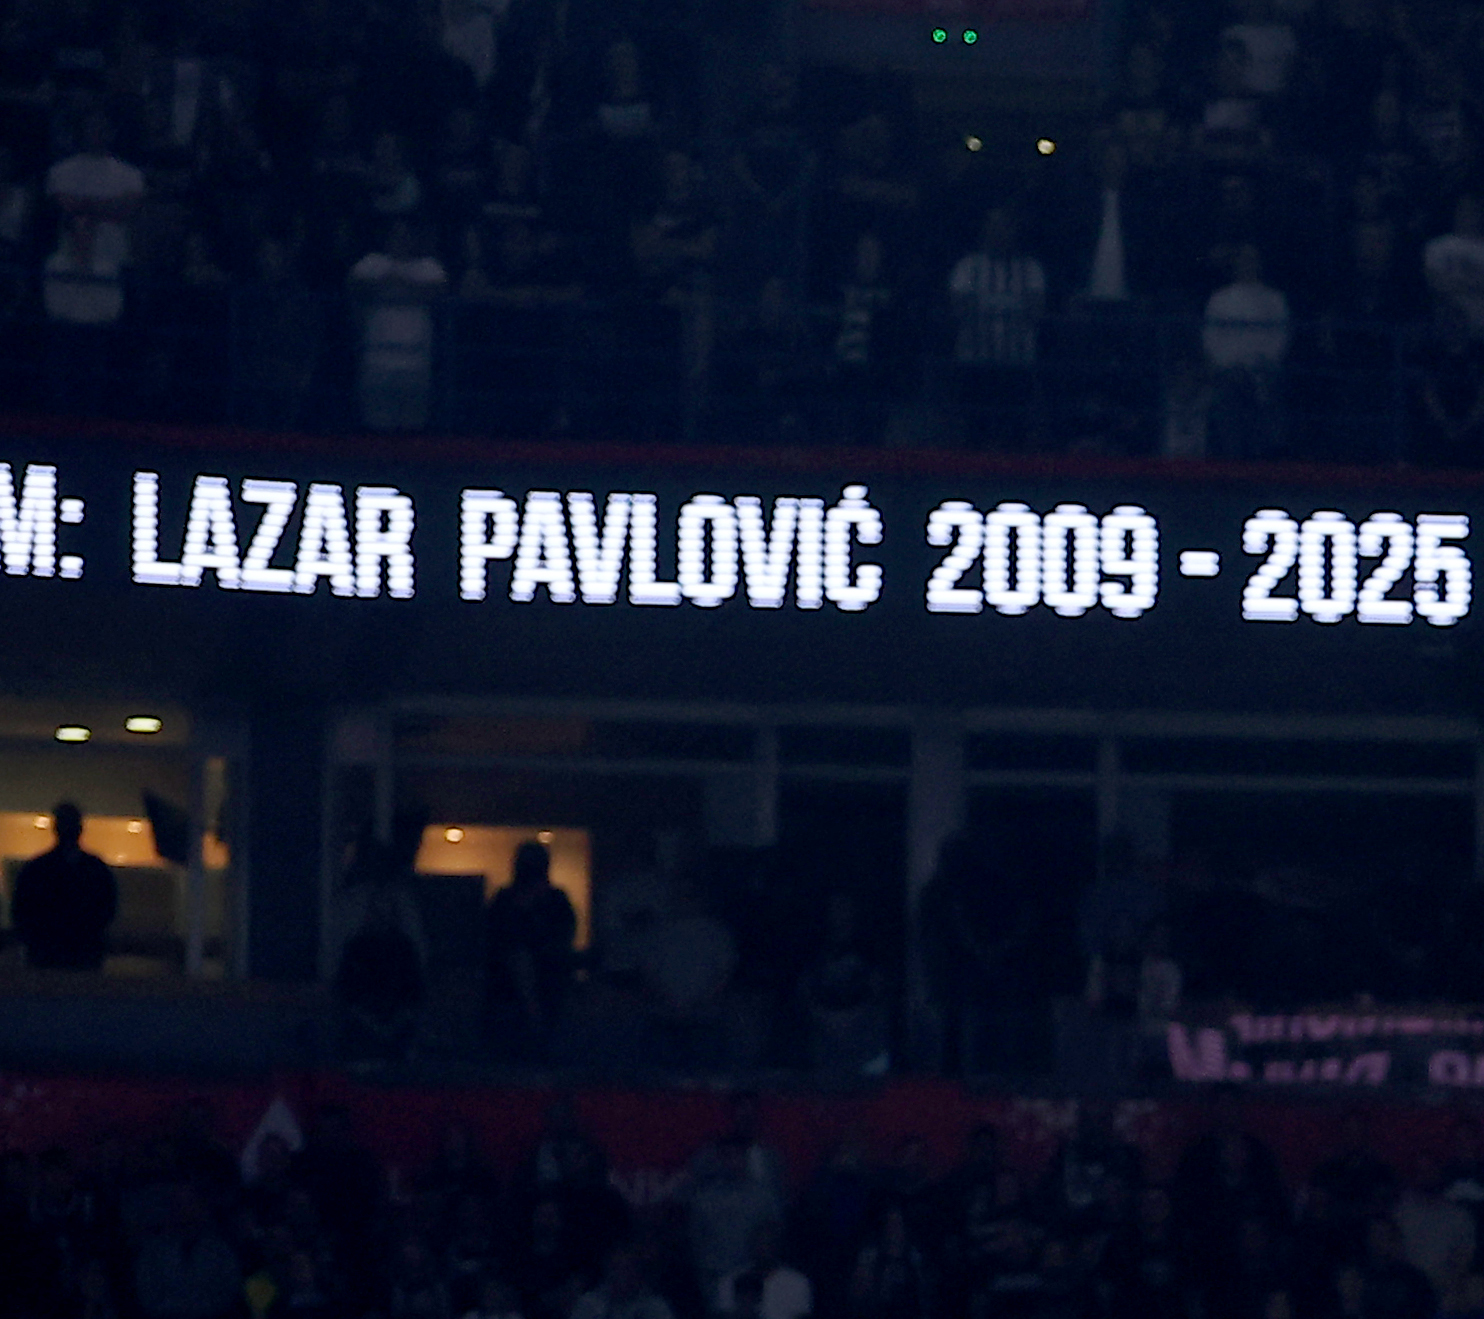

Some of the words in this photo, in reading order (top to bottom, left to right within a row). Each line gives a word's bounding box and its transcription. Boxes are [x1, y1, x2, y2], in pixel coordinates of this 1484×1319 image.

[134, 471, 415, 598] LAZAR
[459, 484, 883, 611] PAVLOVIĆ
[926, 501, 1158, 619] 2009
[1242, 509, 1473, 625] 2025
